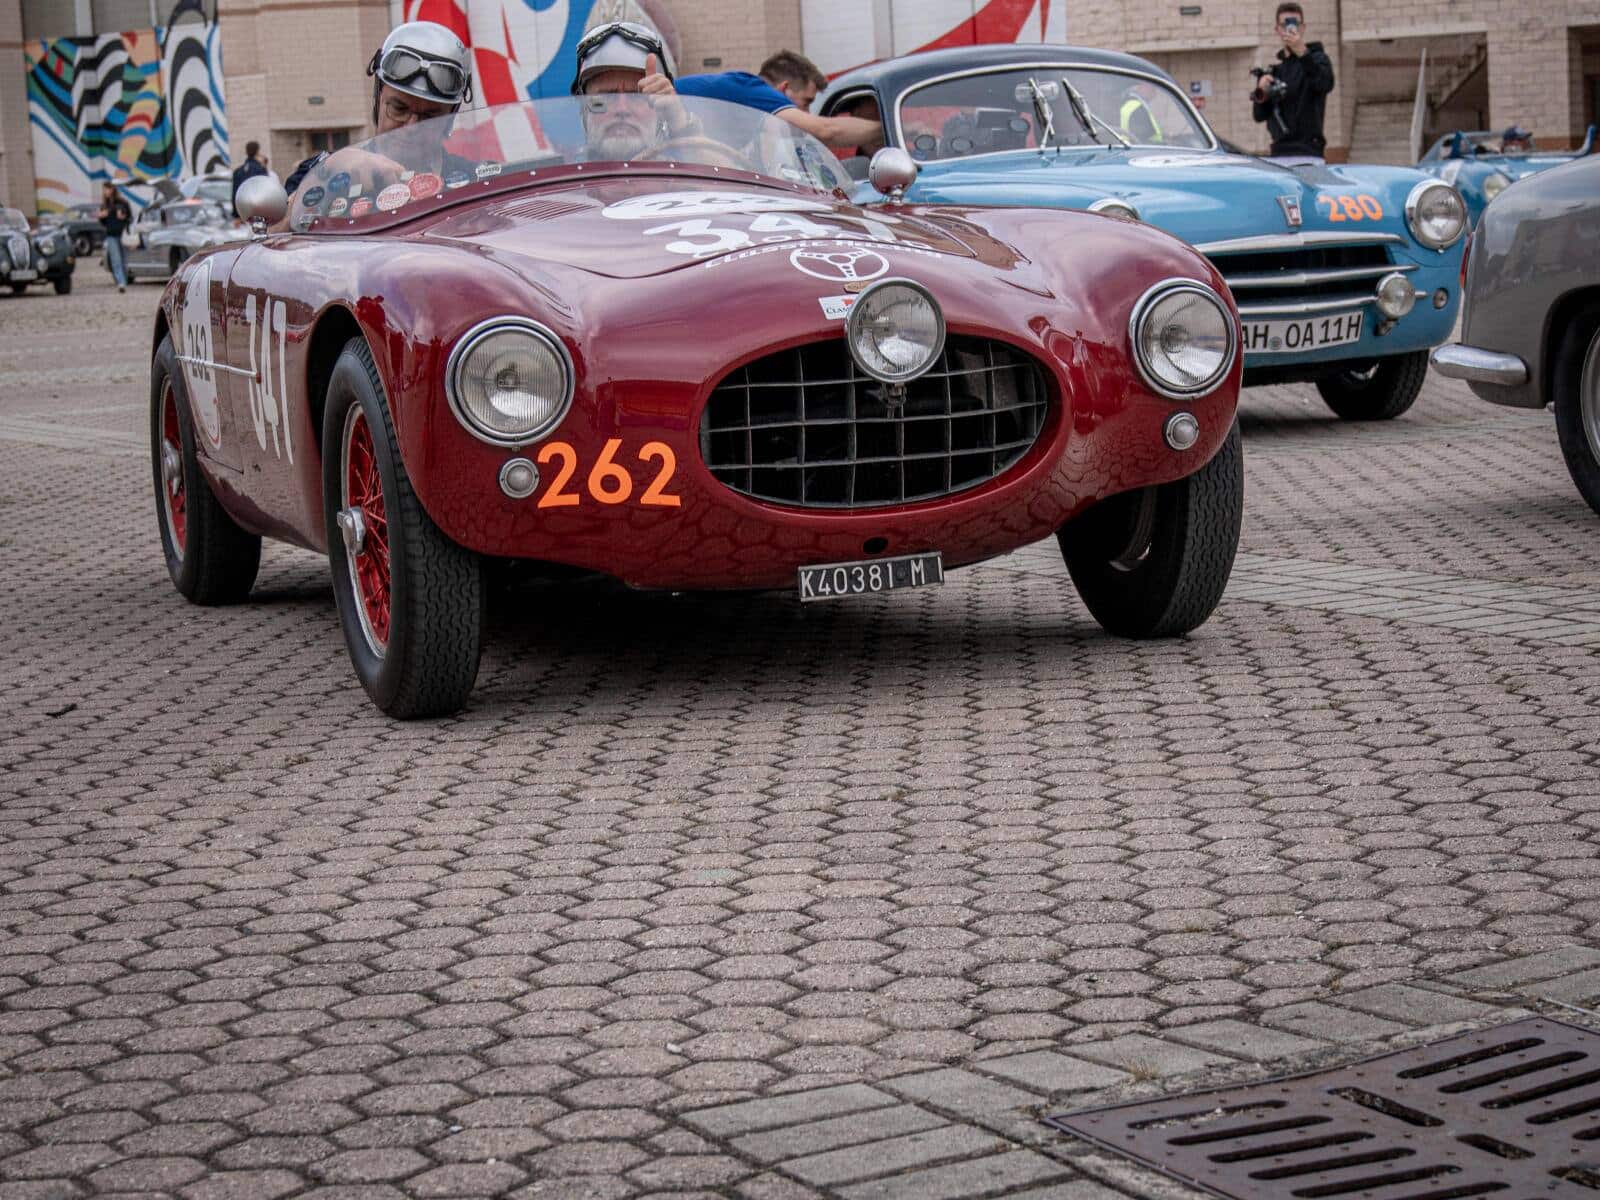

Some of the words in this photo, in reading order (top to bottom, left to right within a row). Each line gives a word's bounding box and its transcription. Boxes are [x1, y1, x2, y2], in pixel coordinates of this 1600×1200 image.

[1318, 194, 1383, 222] 280
[187, 323, 211, 382] 262
[537, 438, 681, 509] 262
[801, 563, 894, 598] K40381
